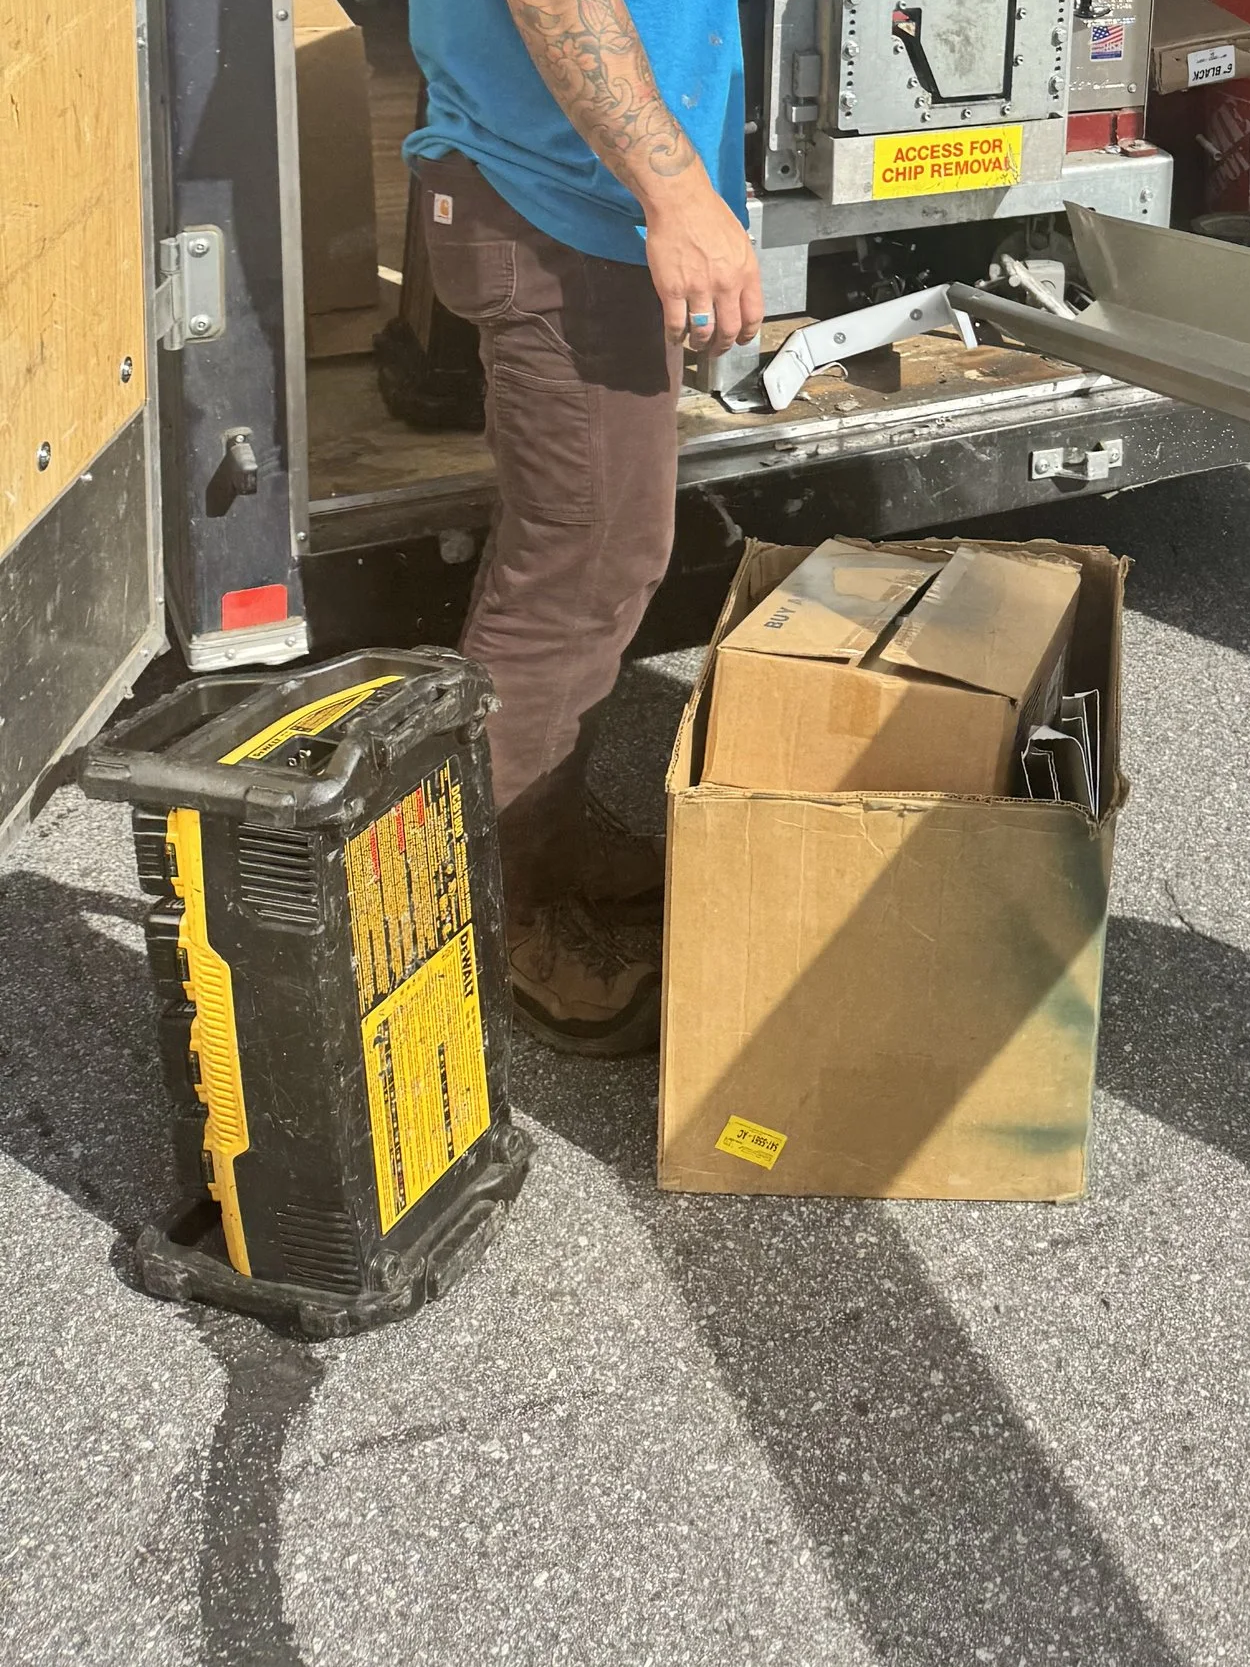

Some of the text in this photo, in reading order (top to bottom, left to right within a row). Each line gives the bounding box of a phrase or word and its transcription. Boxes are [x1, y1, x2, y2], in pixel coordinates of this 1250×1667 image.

[1192, 65, 1222, 81] BLACK
[893, 138, 1003, 164] ACCESS FOR
[882, 165, 925, 183] CHIP
[763, 606, 797, 629] BUY
